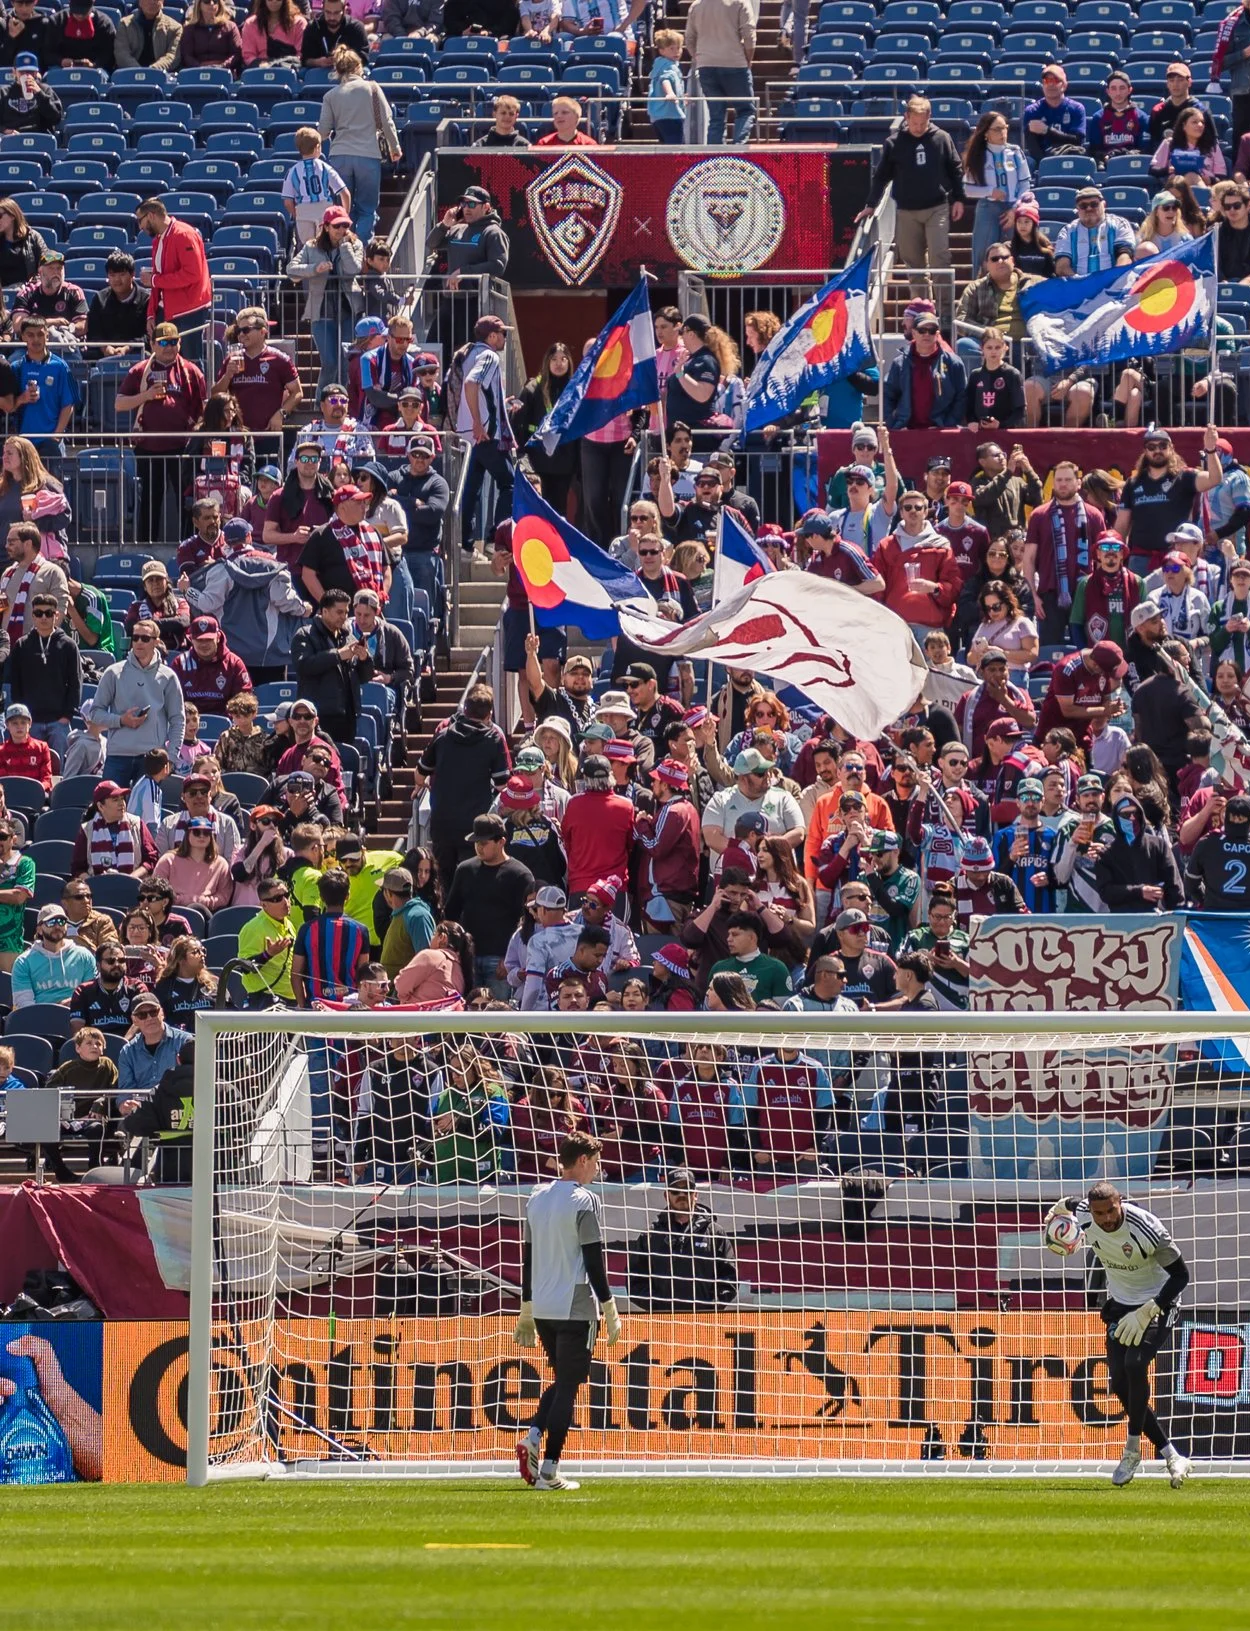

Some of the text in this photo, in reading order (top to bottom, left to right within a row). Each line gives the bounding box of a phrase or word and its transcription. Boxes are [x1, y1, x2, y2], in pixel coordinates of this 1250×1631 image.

[303, 175, 322, 196] 10
[1223, 859, 1248, 895] 2
[92, 1012, 129, 1025] uchealth
[864, 1323, 1128, 1430] Tire
